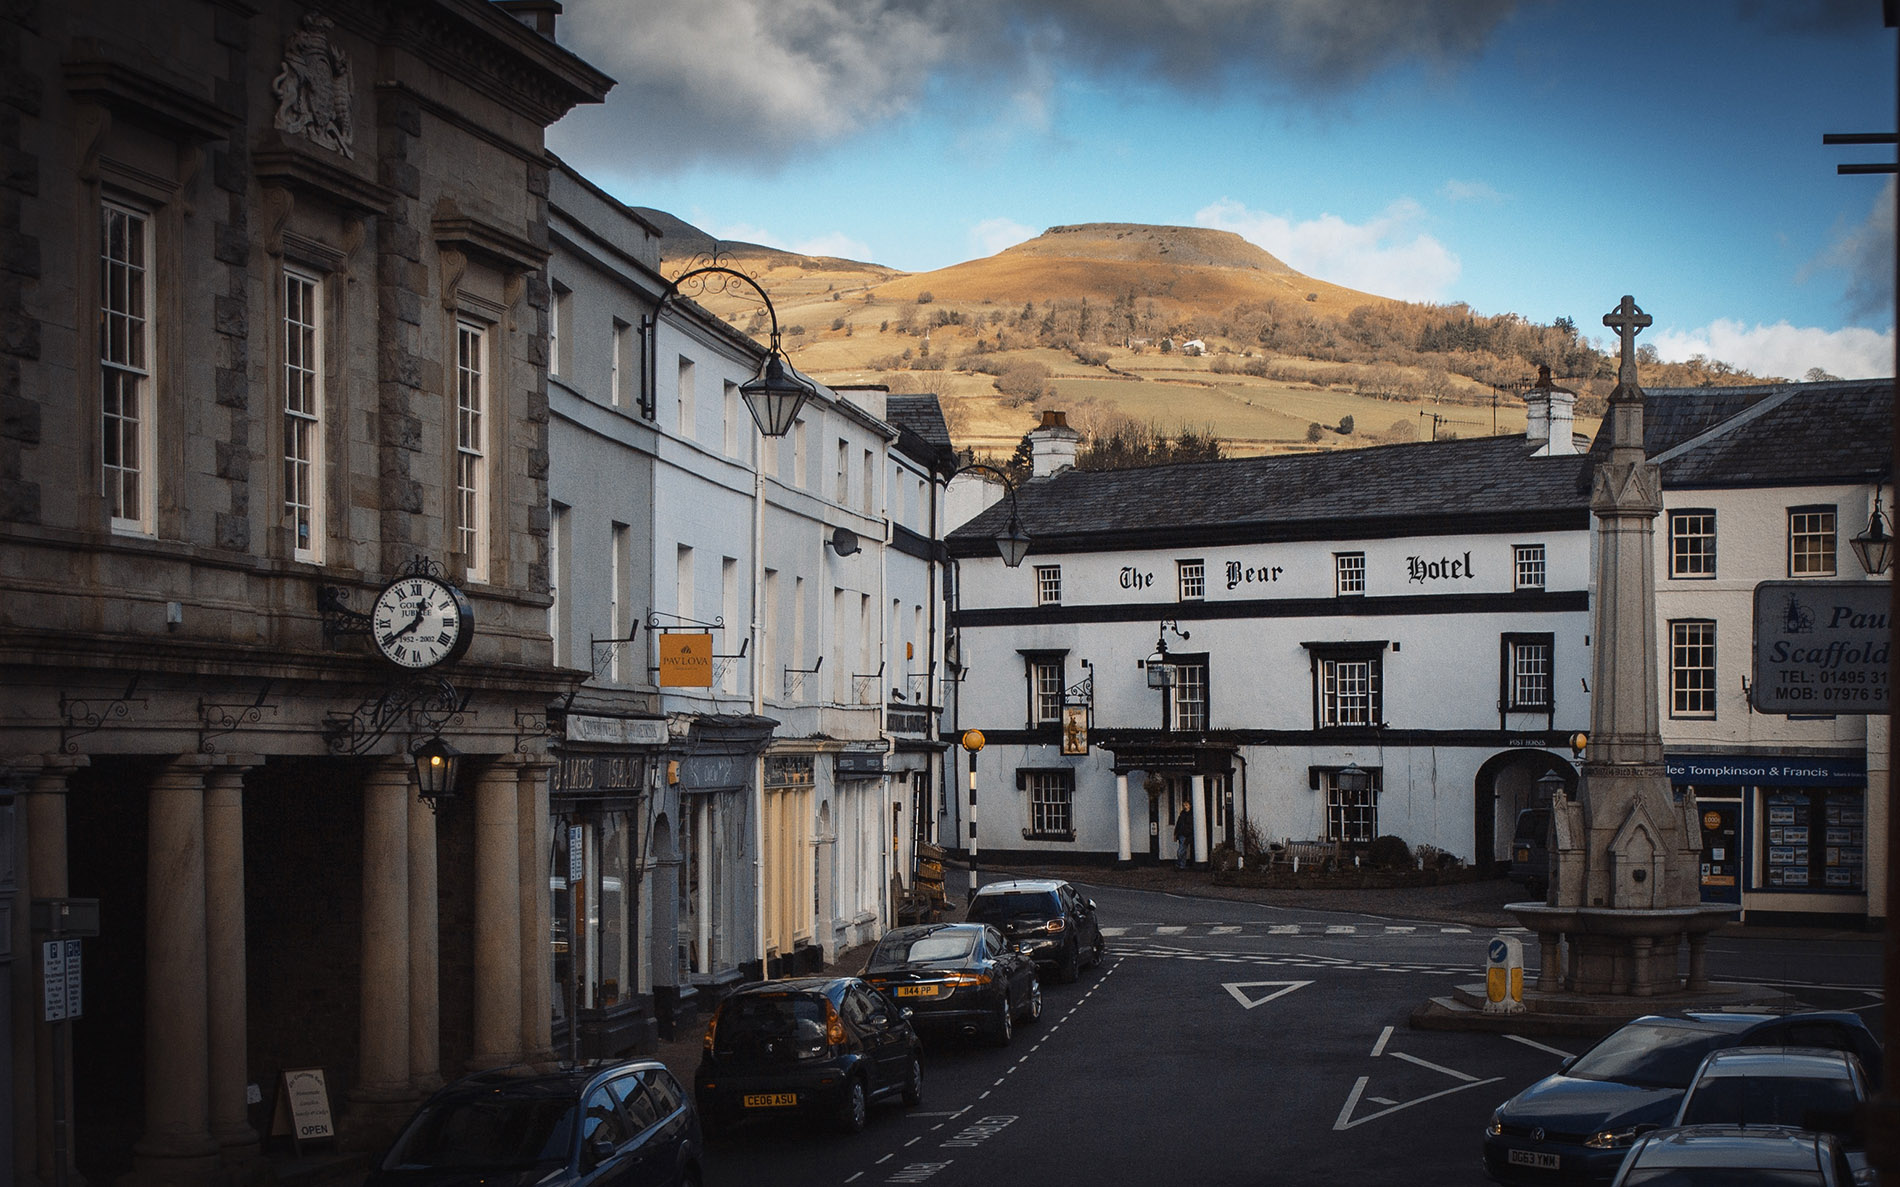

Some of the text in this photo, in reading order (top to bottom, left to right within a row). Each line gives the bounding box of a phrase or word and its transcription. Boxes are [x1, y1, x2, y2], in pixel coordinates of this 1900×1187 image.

[1119, 551, 1476, 590] The Bear Hotel
[1769, 640, 1890, 669] Scaffold
[663, 657, 708, 665] PAVLOVA
[1780, 670, 1815, 683] TEL:
[1820, 671, 1866, 683] 01495
[1776, 687, 1818, 700] MOB:
[1824, 687, 1869, 700] 07976
[1667, 765, 1685, 775] lee
[1689, 765, 1765, 777] Tompkinson
[1769, 766, 1780, 777] &
[1783, 766, 1829, 777] Francis
[748, 1094, 794, 1105] CE06 ASU
[301, 1125, 328, 1135] OPEN
